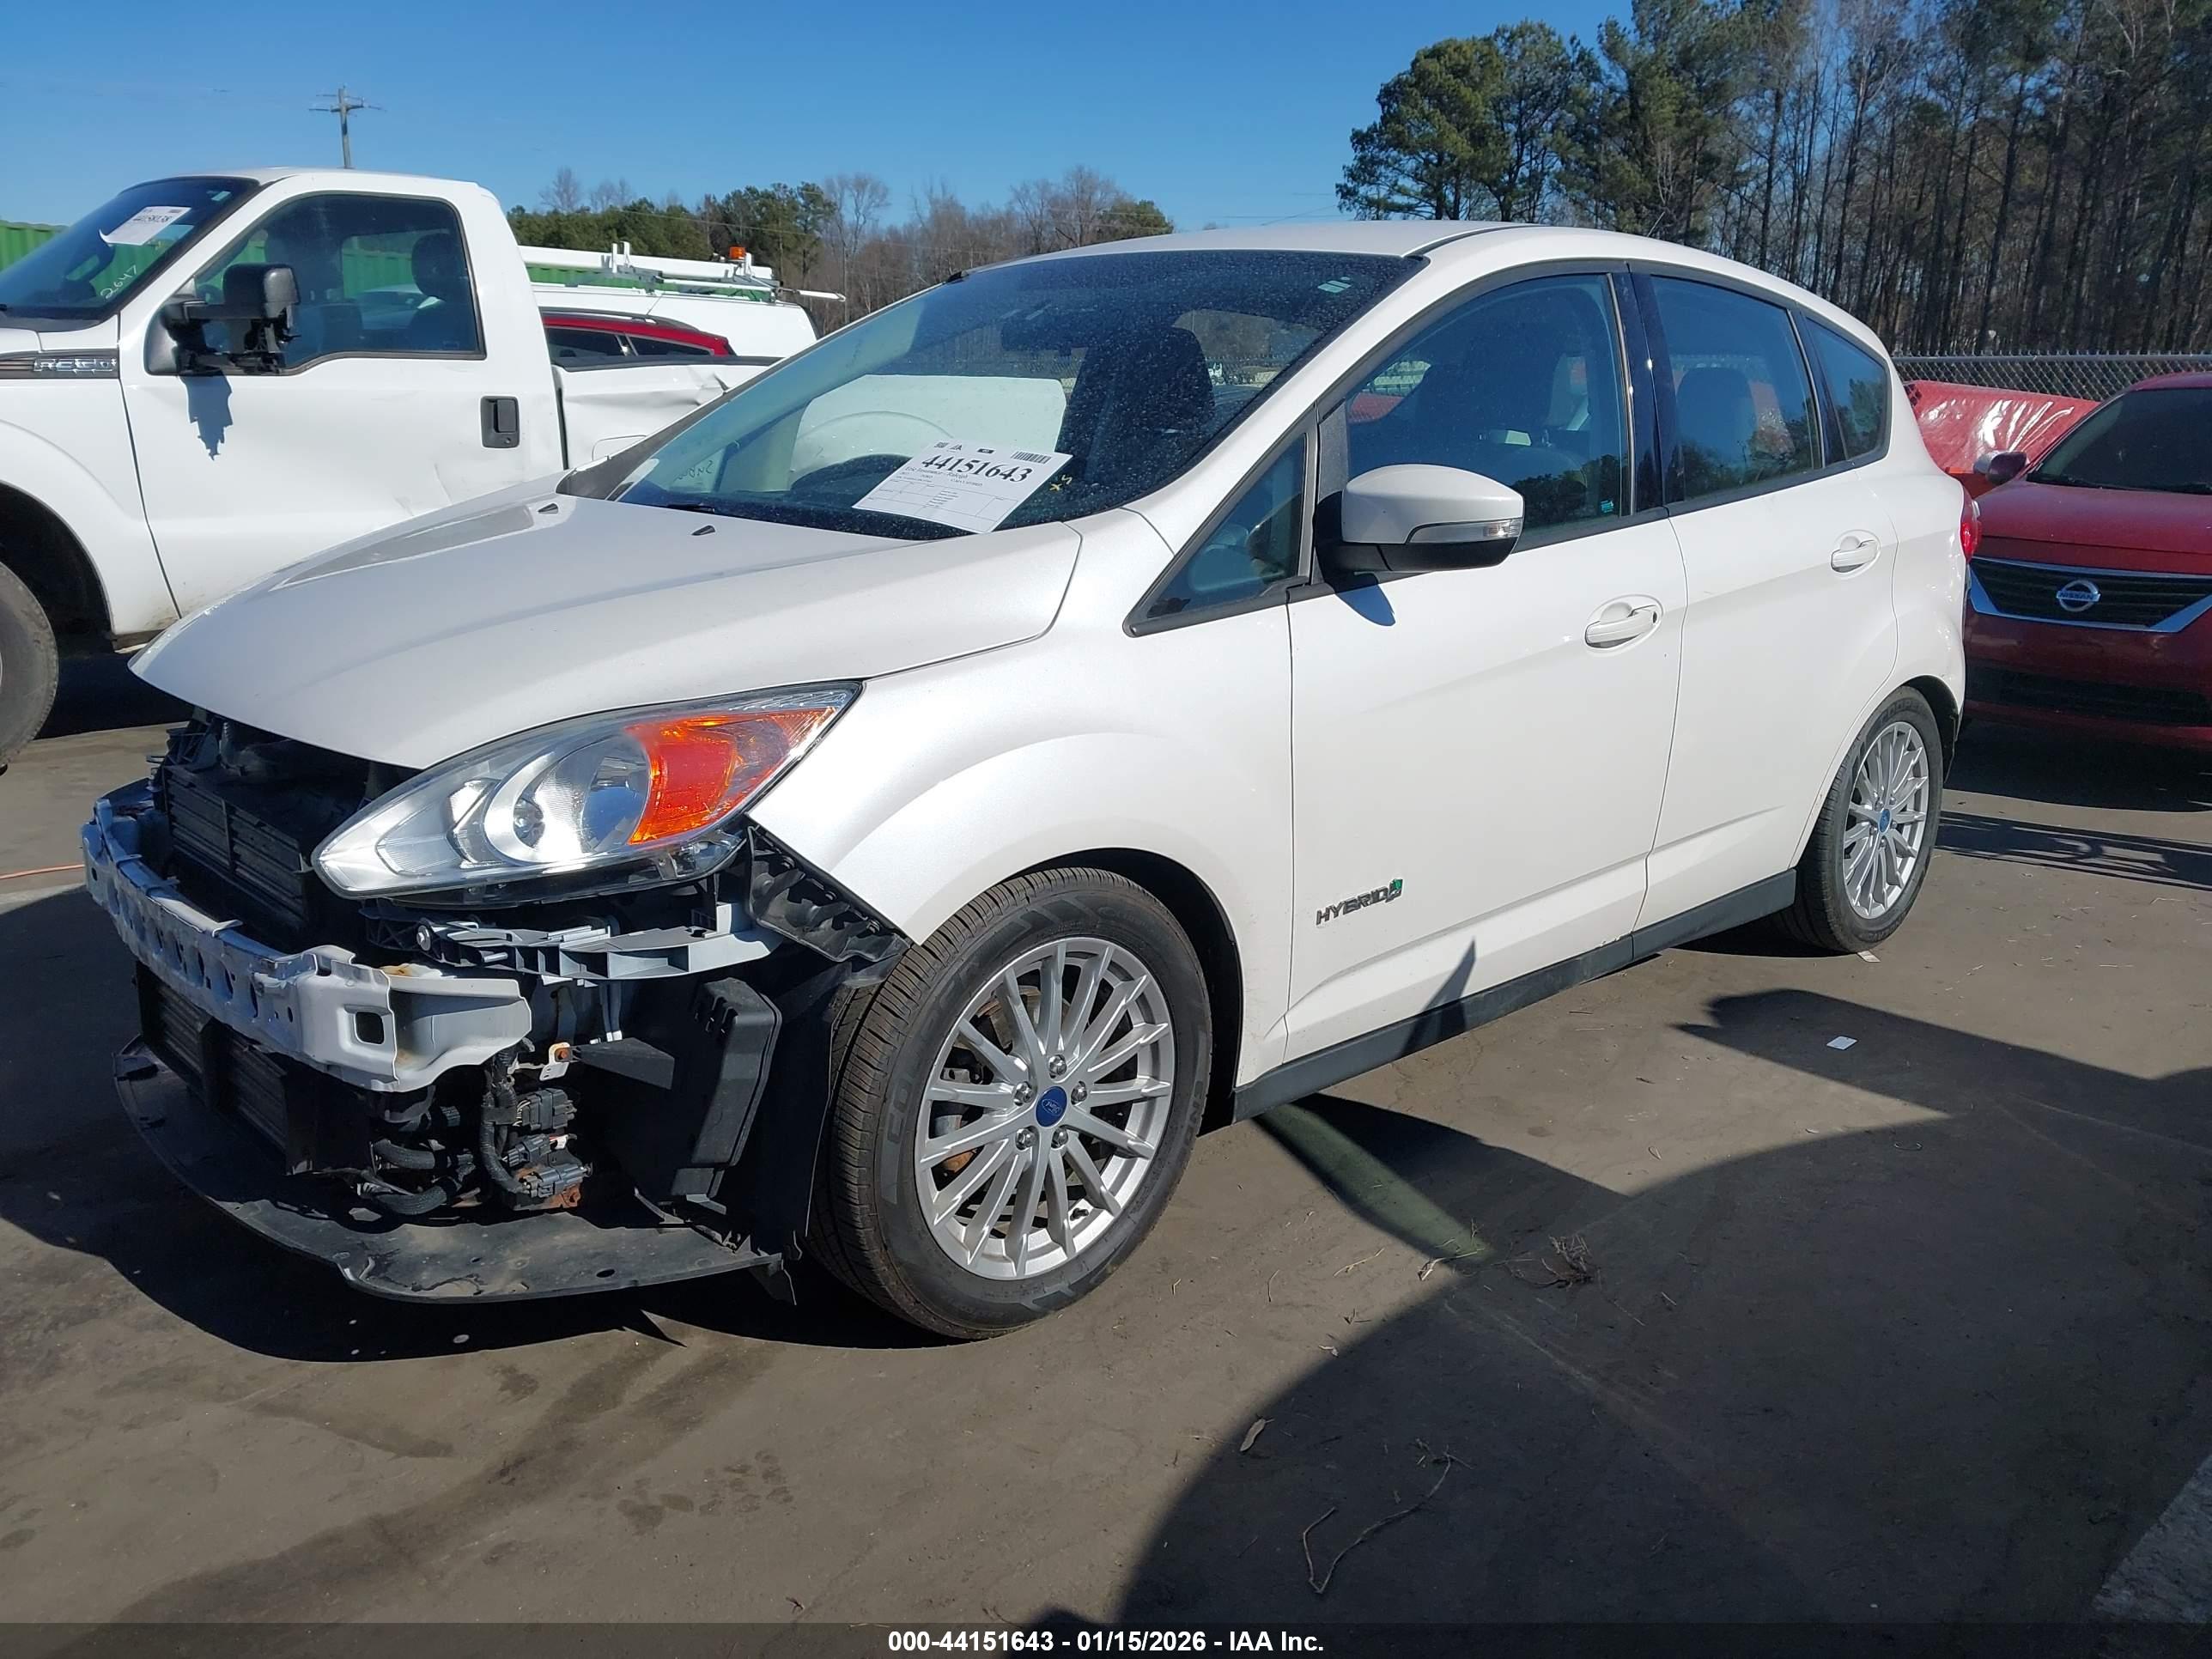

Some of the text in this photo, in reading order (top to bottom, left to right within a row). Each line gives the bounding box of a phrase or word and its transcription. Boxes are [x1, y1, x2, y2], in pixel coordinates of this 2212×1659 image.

[100, 264, 137, 300] 2647
[921, 454, 1033, 483] 44151643
[2058, 591, 2095, 600] NISSAN
[1316, 885, 1389, 927] HYBRID
